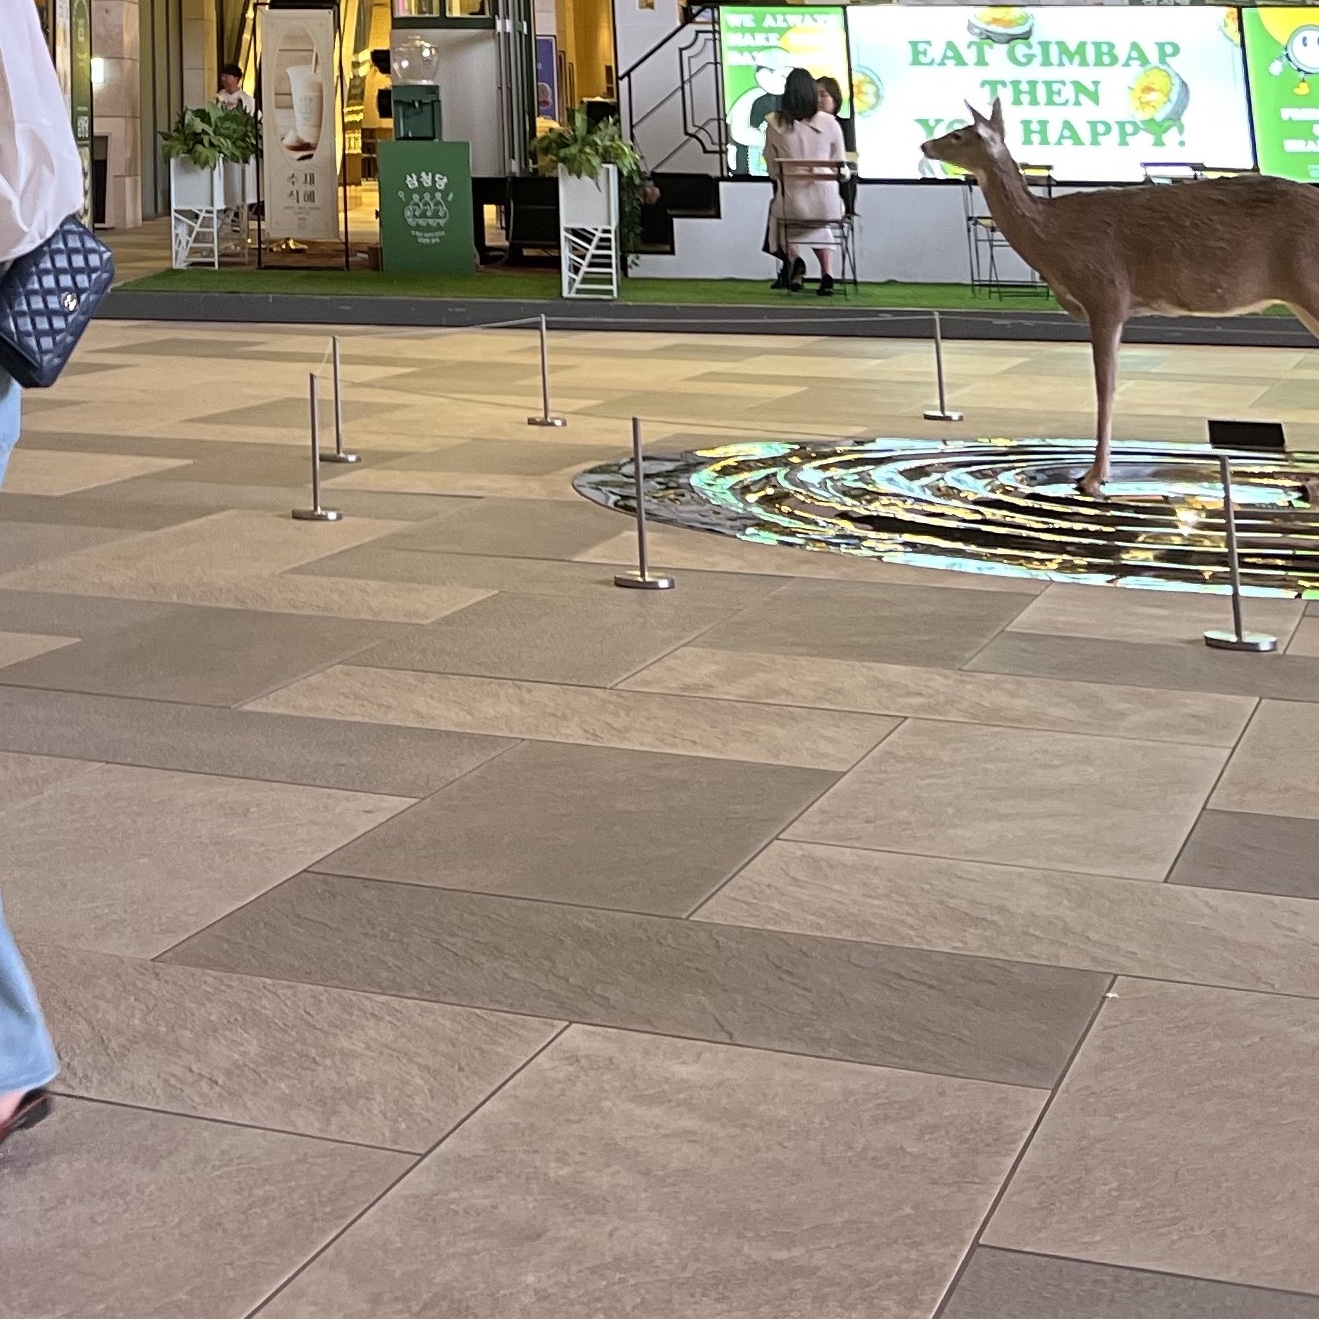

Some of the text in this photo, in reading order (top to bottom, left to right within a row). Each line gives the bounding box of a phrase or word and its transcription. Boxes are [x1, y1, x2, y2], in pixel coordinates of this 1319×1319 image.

[725, 13, 756, 28] WE
[908, 39, 1181, 68] EAT GIMBAP
[980, 79, 1102, 107] THEN
[1020, 117, 1186, 147] HAPPY!
